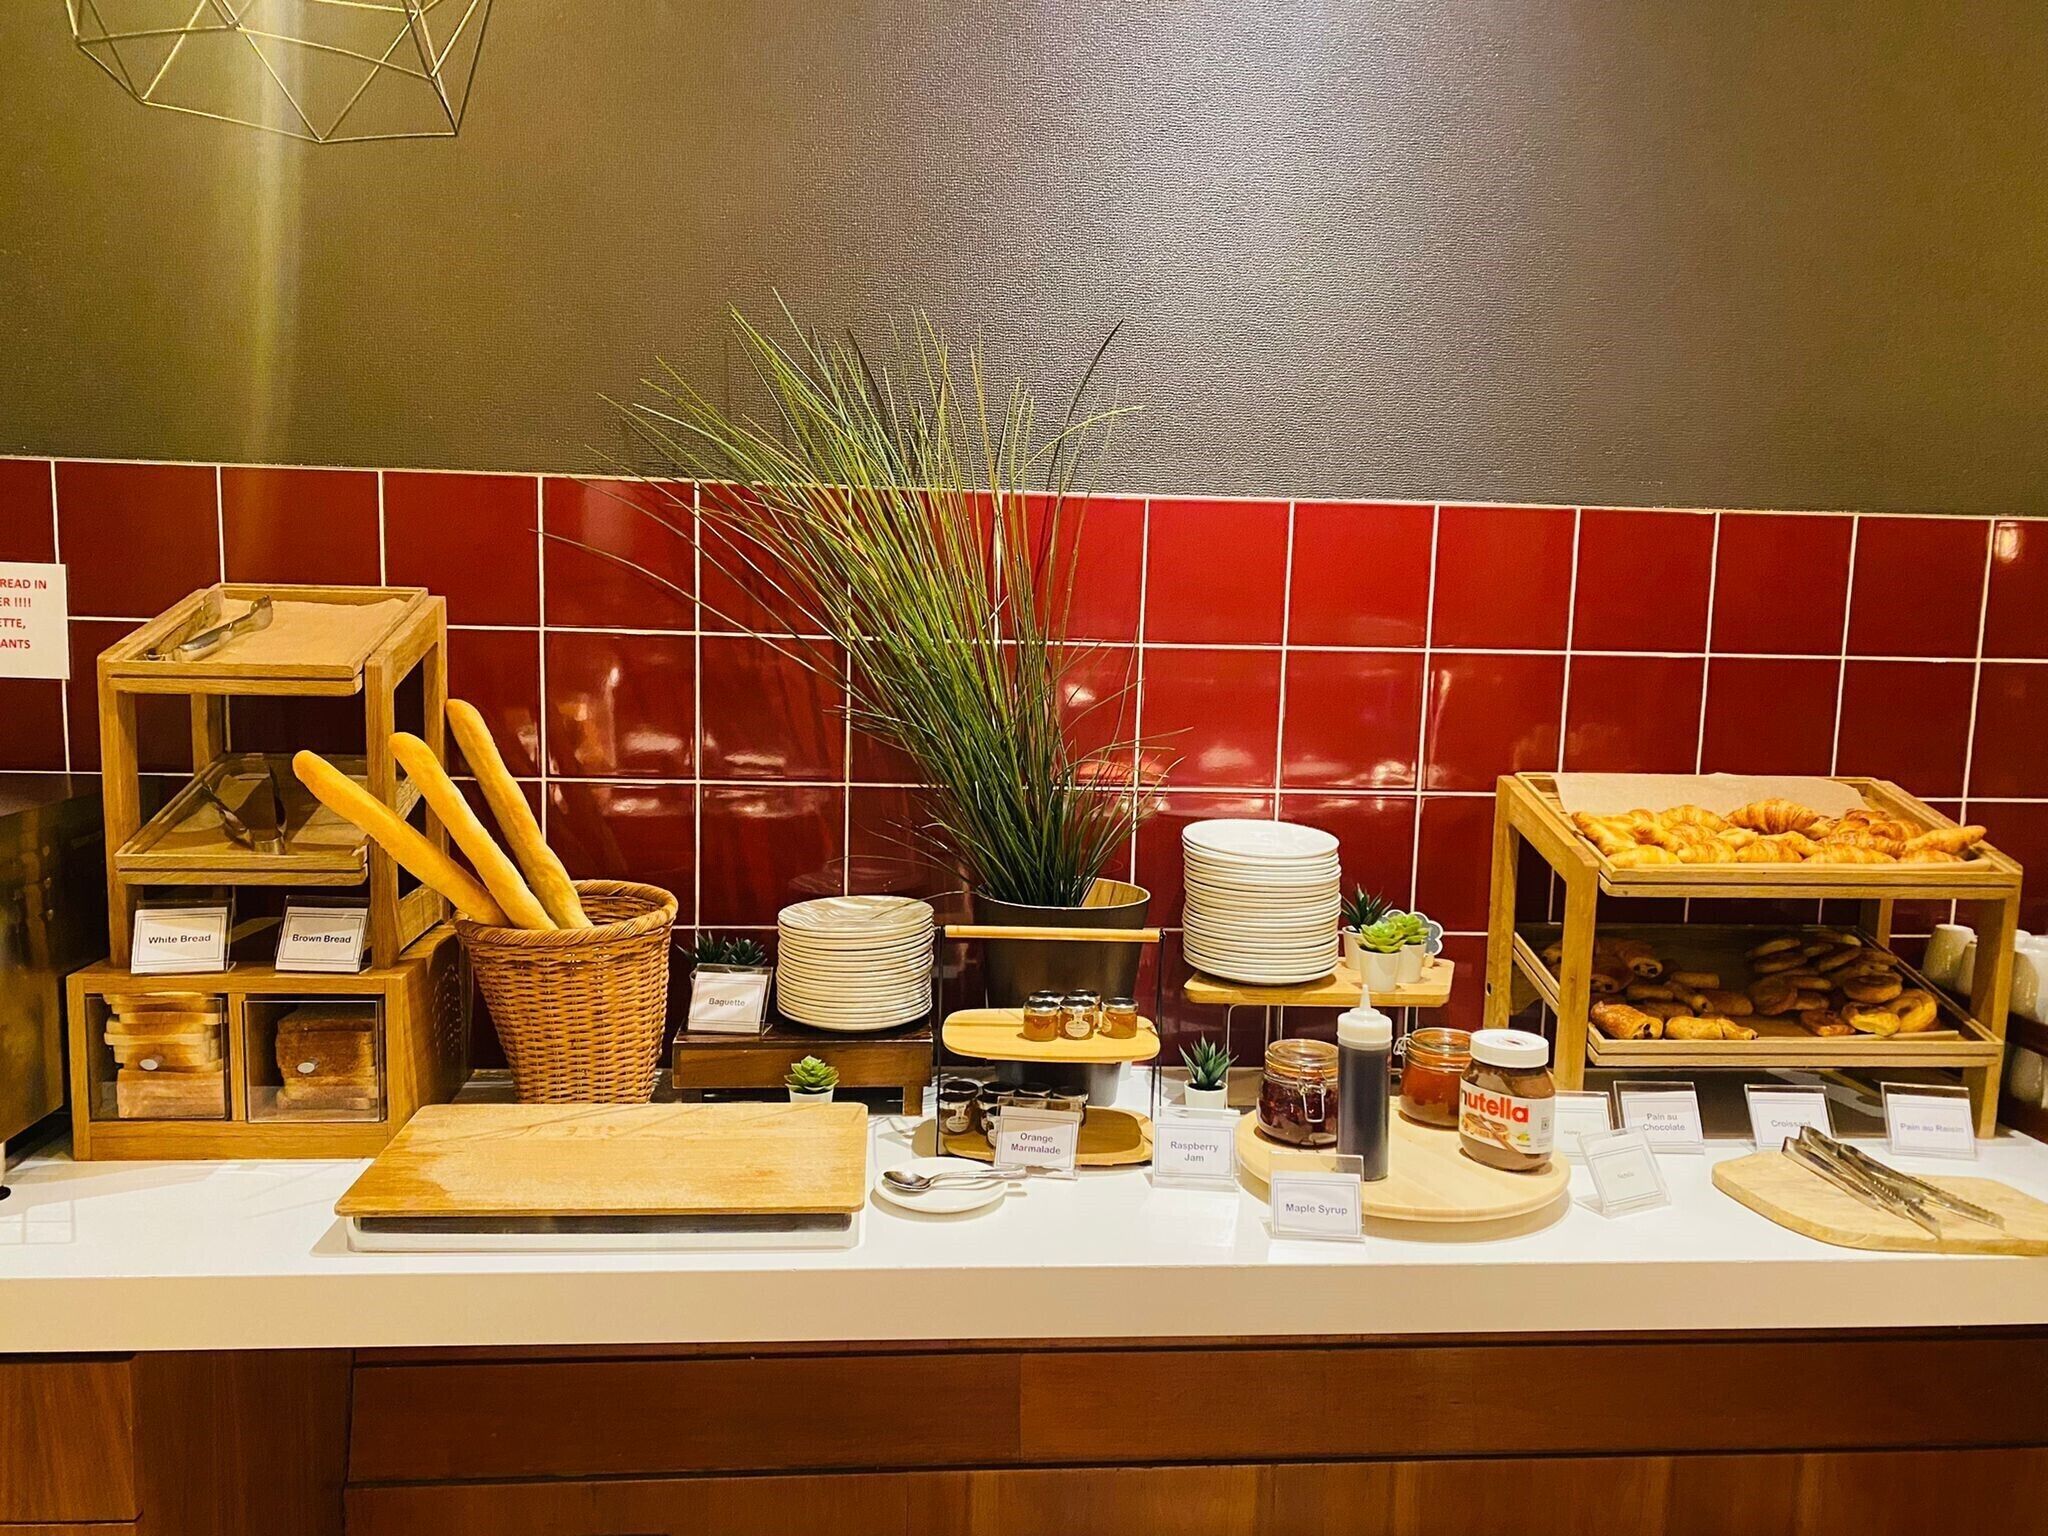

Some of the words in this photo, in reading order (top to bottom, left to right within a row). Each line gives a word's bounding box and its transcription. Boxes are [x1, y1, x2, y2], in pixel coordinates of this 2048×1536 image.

[34, 580, 47, 589] IN
[148, 936, 178, 944] White
[180, 934, 211, 943] Bread
[292, 933, 322, 942] Brown
[323, 934, 352, 943] Bread
[708, 997, 746, 1008] Baguette
[1461, 1090, 1529, 1123] nutella
[1642, 1123, 1686, 1131] Chocolate
[1900, 1122, 1920, 1130] Pain
[1020, 1132, 1053, 1143] Orange
[1010, 1143, 1061, 1155] Marmalade
[1170, 1141, 1219, 1152] Raspberry
[1184, 1153, 1205, 1162] Jam
[1285, 1203, 1316, 1214] Maple
[1318, 1204, 1348, 1216] Syrup
